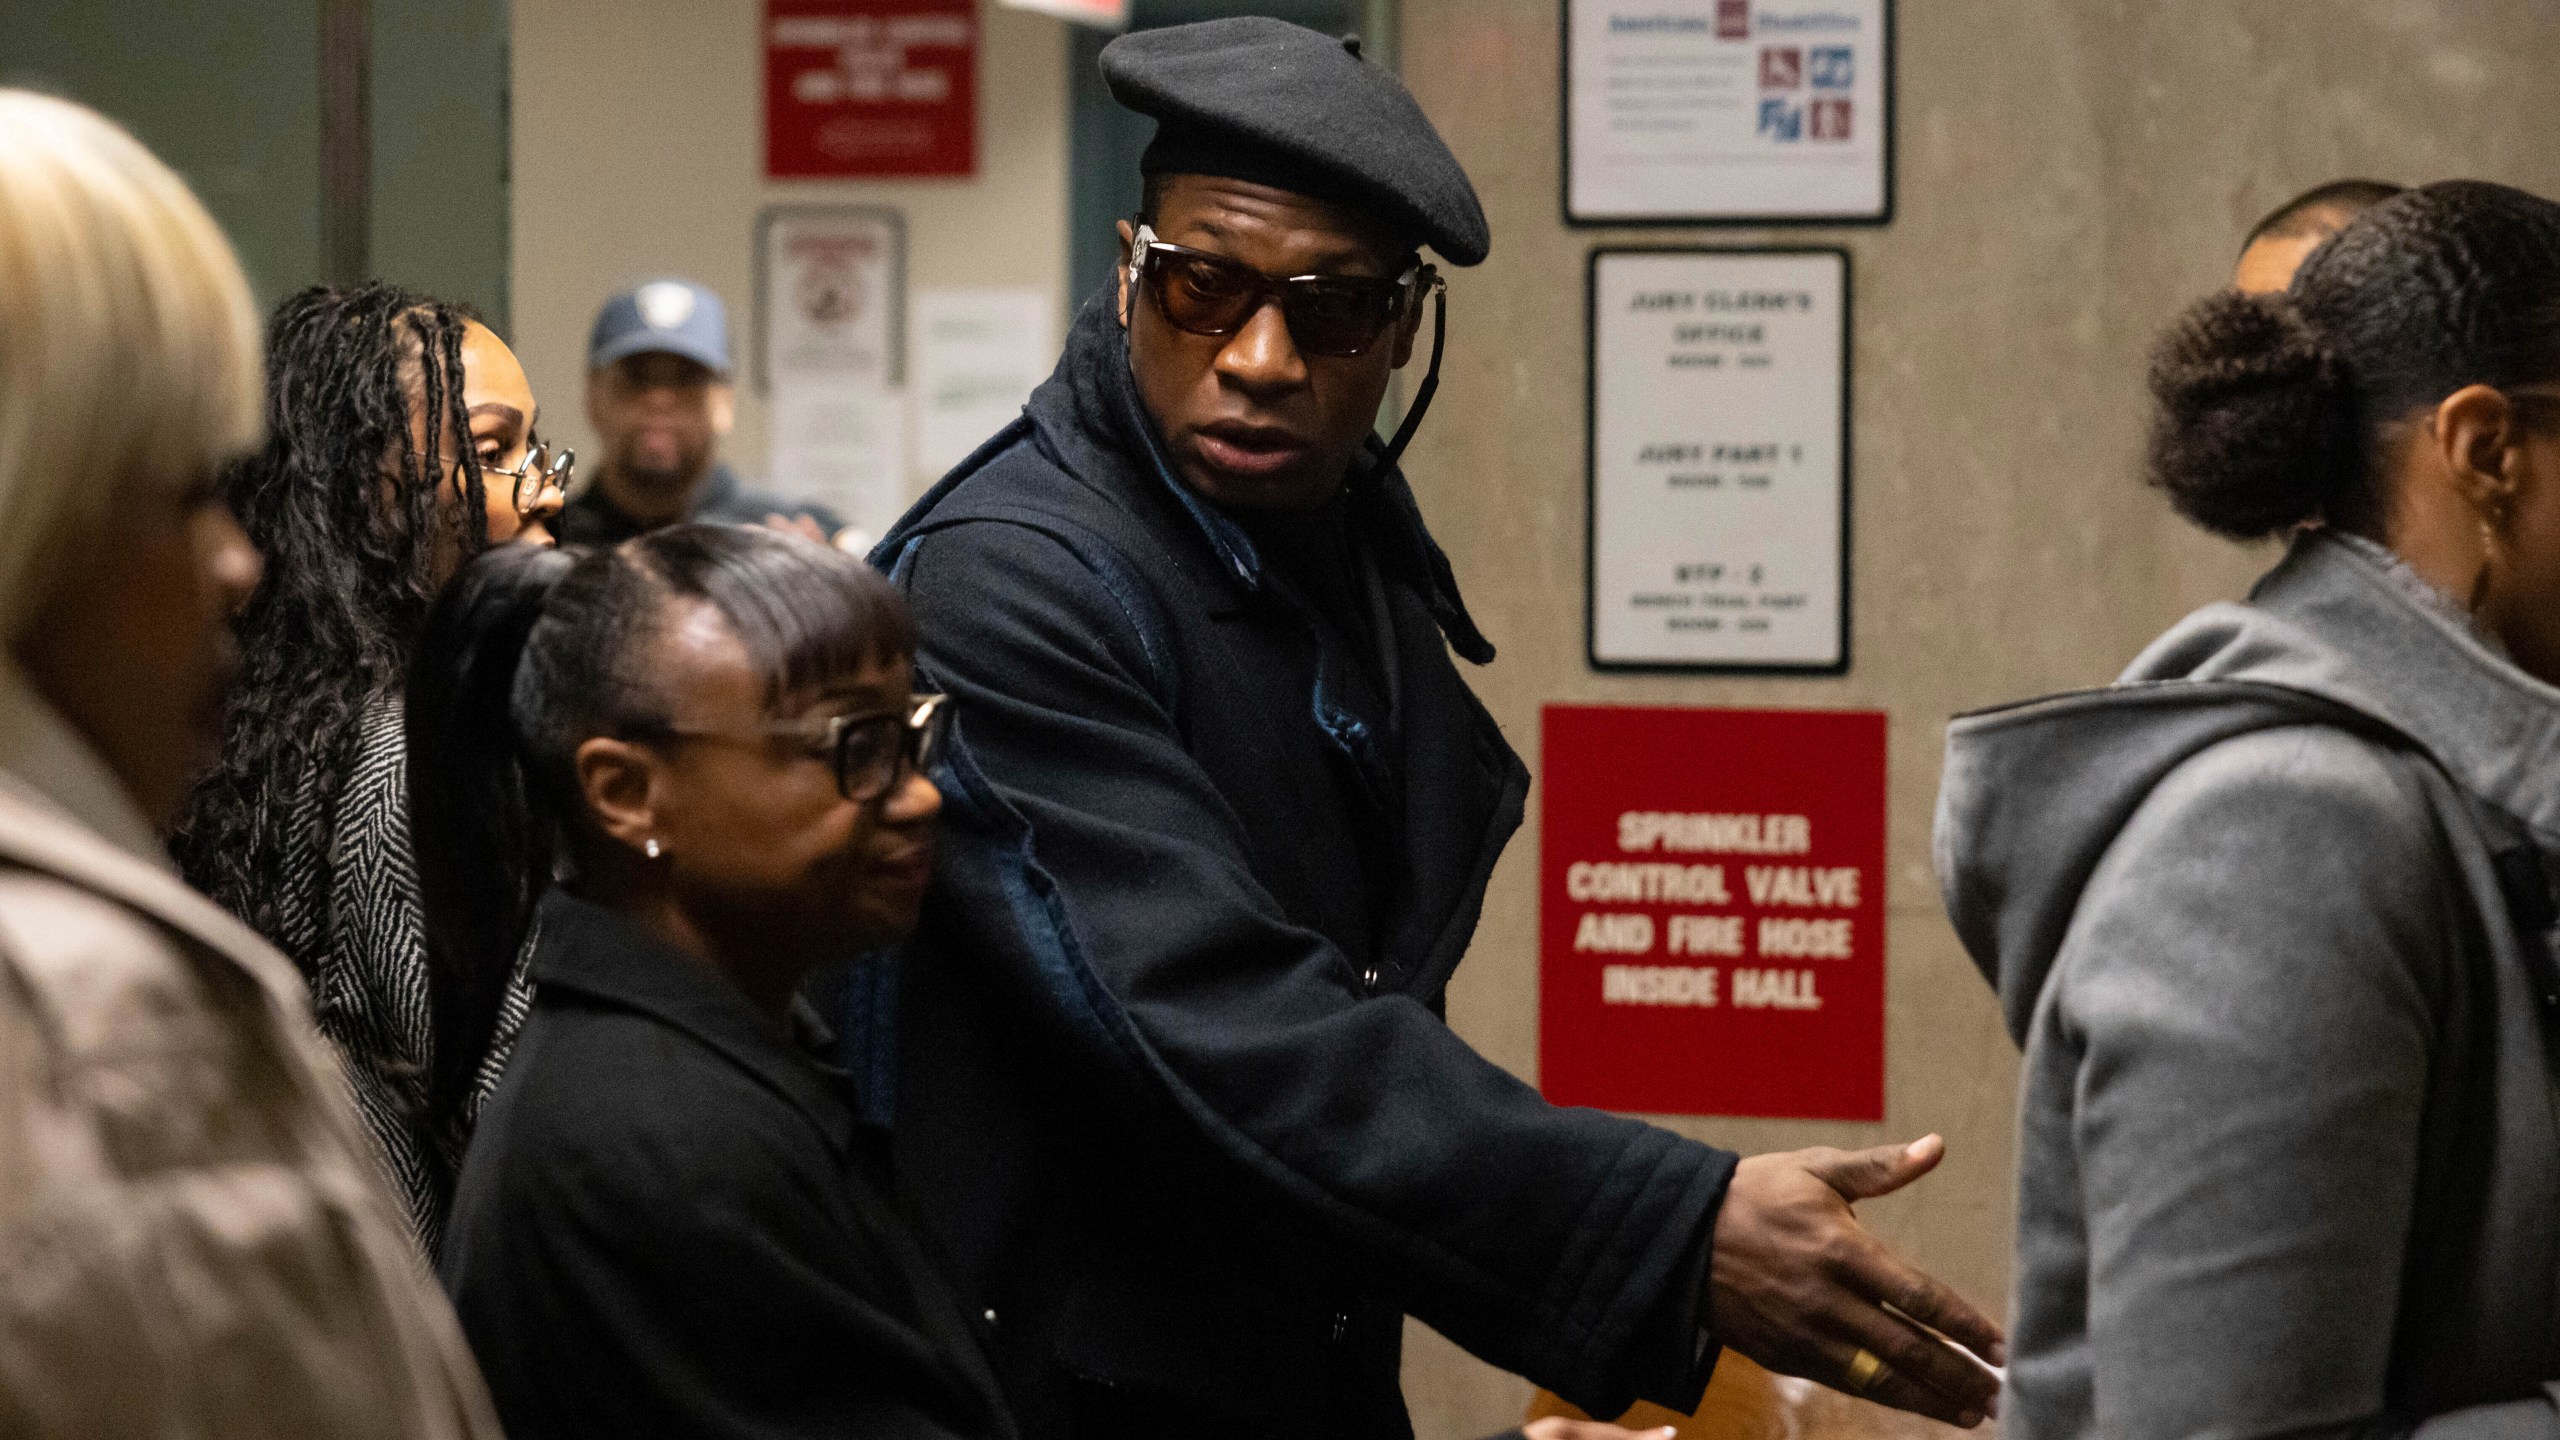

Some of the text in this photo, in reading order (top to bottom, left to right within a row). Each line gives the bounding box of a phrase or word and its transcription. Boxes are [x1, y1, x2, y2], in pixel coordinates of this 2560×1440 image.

[1631, 290, 1694, 313] JURY
[1674, 323, 1764, 343] OFFICE
[1637, 444, 1700, 464] JURY
[1711, 443, 1778, 464] PART
[1617, 811, 1811, 855] SPRINKLER
[1566, 860, 1861, 908] CONTROL VALVE
[1574, 912, 1853, 960] AND FIRE HOSE
[1602, 964, 1822, 1011] INSIDE HALL
